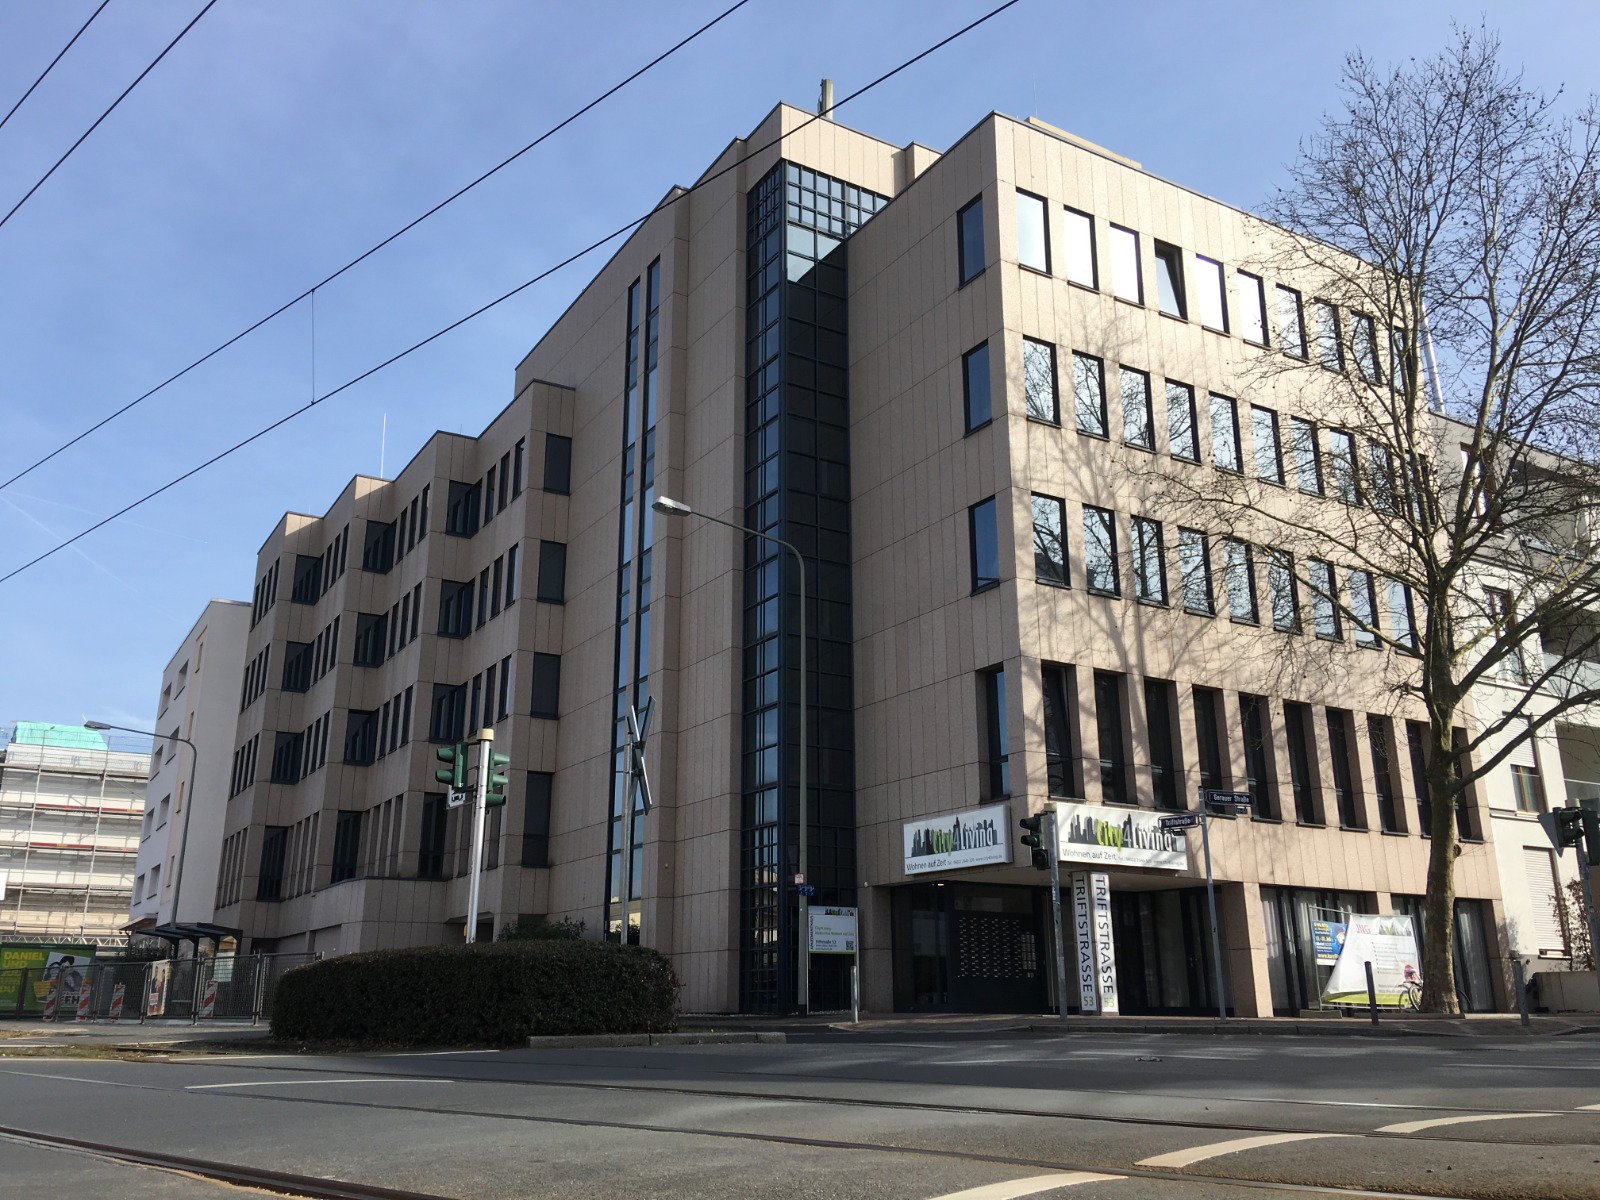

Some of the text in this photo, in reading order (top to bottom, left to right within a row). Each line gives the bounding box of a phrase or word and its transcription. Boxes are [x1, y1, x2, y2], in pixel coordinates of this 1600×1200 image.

[1213, 793, 1249, 803] Gerauer Straße
[1062, 848, 1091, 859] Wohnen
[1092, 852, 1102, 860] auf
[1104, 852, 1117, 860] Zeit
[906, 862, 927, 871] Wohnen
[928, 860, 936, 868] auf
[1095, 876, 1114, 994] TRIFTSTRASSE
[1075, 875, 1094, 1007] TRIFTSTRASSE 53
[4, 951, 45, 960] DANIEL
[2, 960, 28, 968] UND
